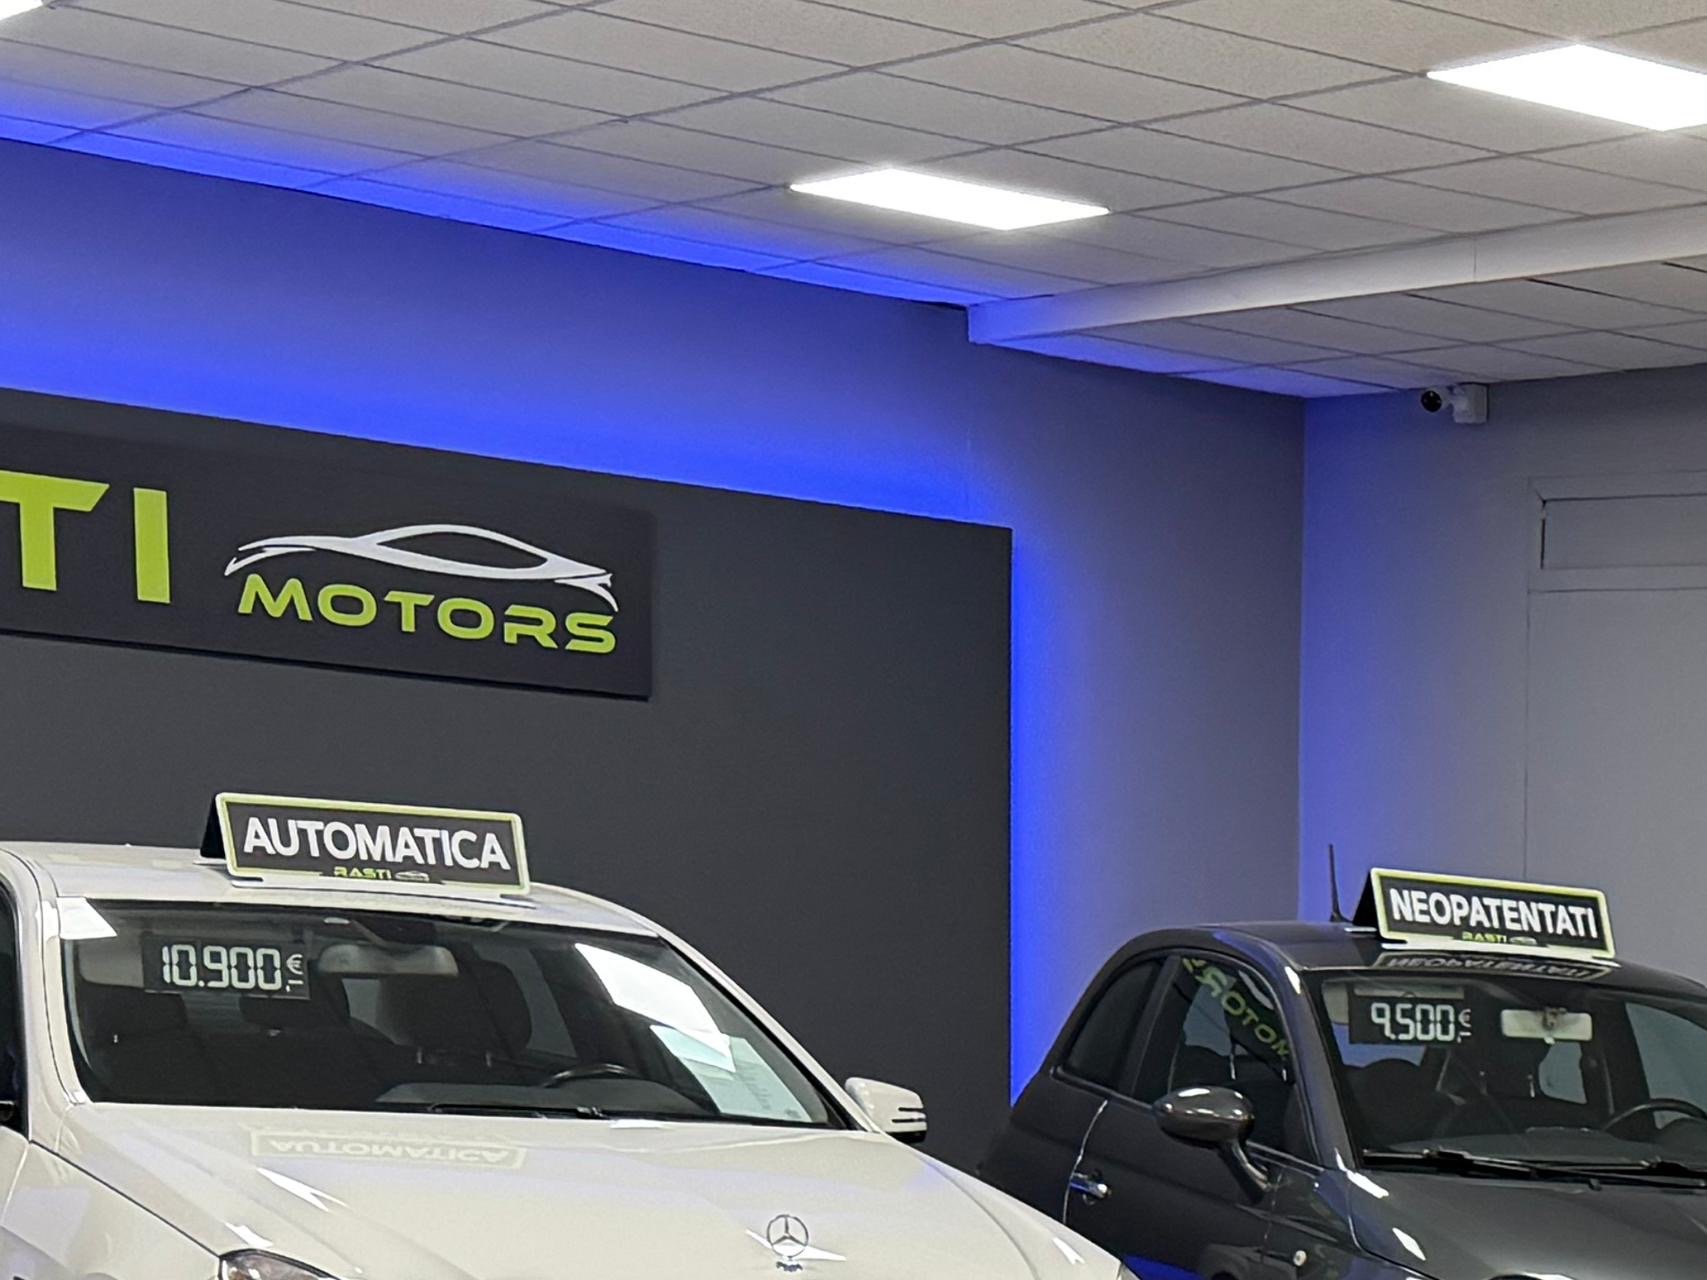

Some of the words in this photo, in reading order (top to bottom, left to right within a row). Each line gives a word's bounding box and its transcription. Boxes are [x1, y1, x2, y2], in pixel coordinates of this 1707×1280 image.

[238, 573, 618, 655] MOTORS
[243, 815, 512, 871] AUTOMATICA
[333, 866, 392, 880] RASTI
[1389, 887, 1599, 938] NEOPATENTATI
[162, 944, 282, 990] 10.900
